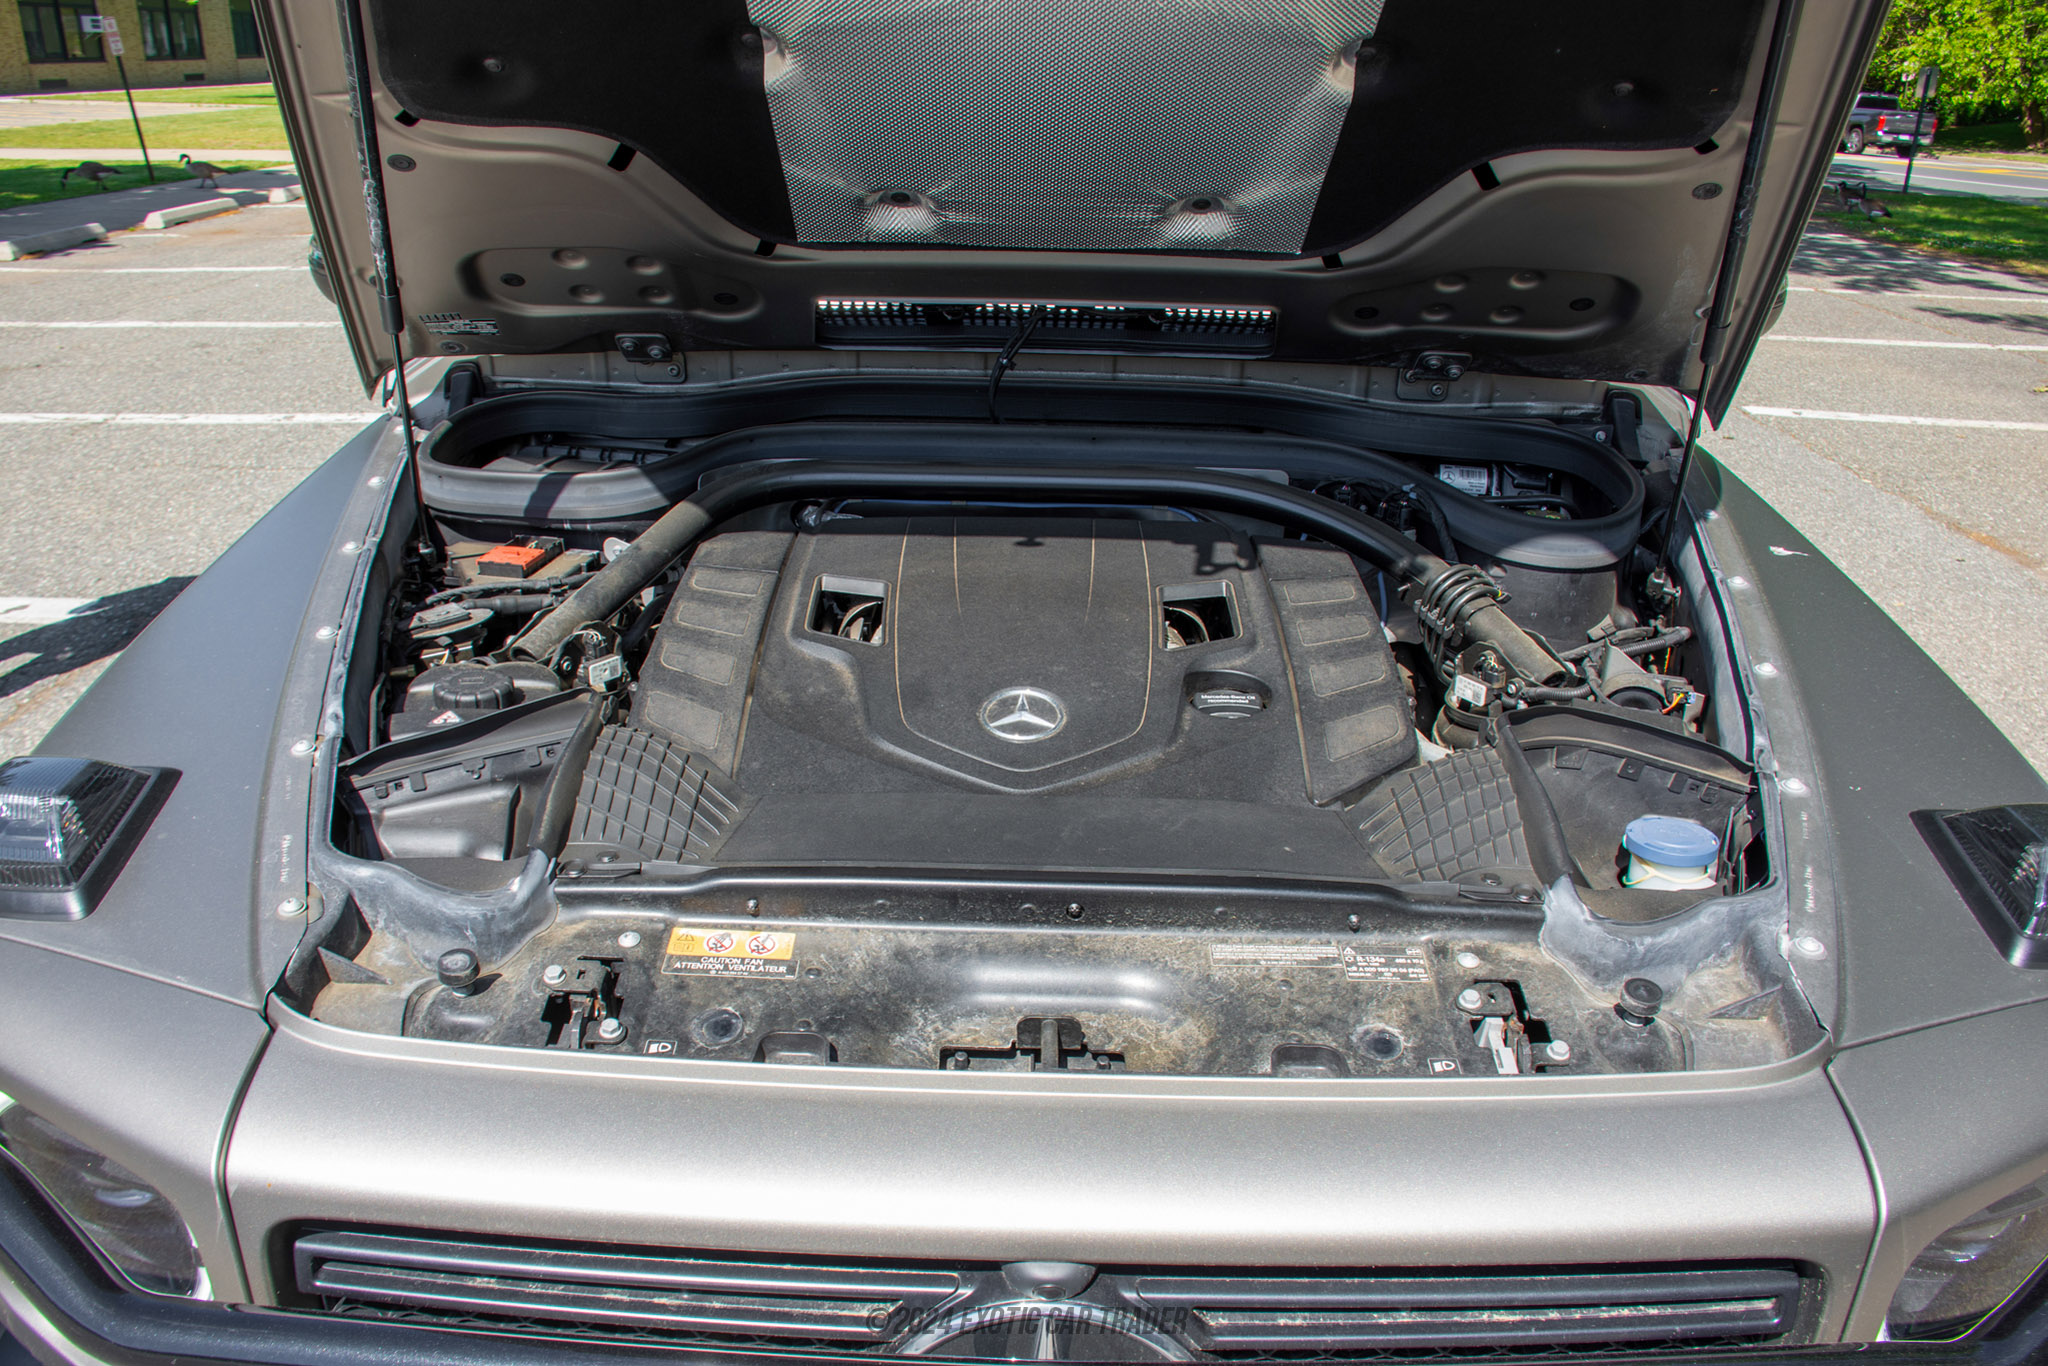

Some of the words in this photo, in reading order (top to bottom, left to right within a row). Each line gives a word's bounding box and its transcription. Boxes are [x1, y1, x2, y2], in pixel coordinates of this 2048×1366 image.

[701, 956, 740, 965] CAUTION
[744, 957, 764, 966] FAN
[673, 961, 724, 971] ATTENTION
[729, 963, 787, 973] VENTILATEUR
